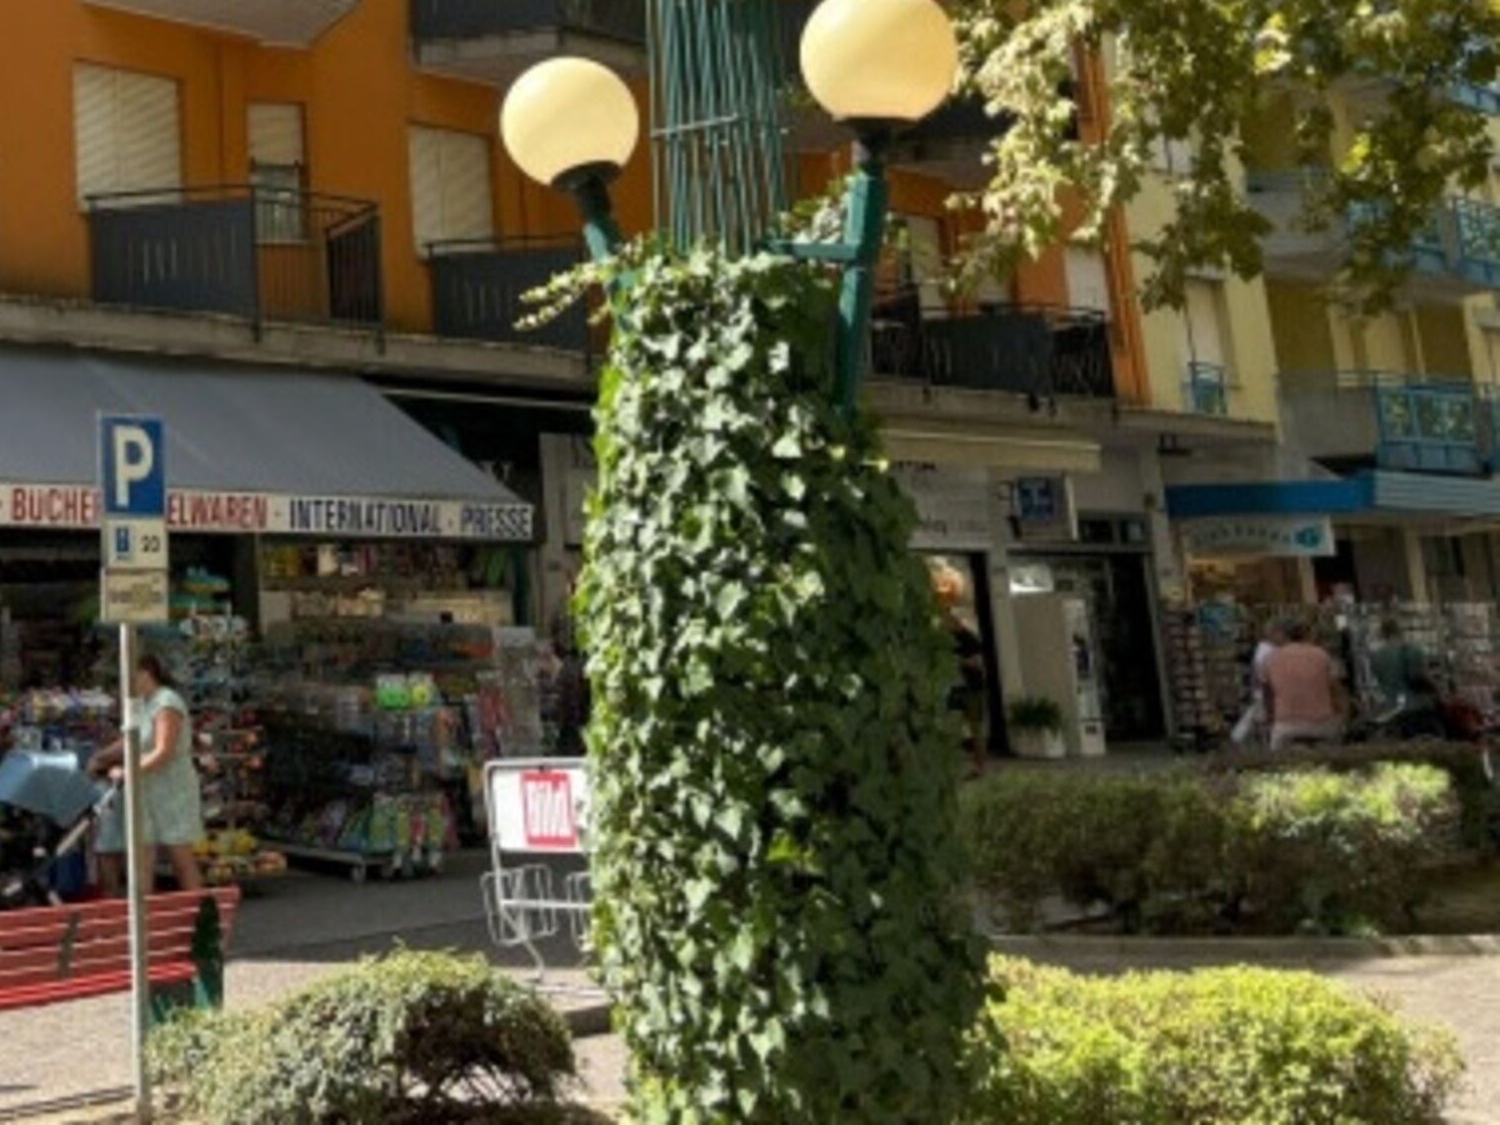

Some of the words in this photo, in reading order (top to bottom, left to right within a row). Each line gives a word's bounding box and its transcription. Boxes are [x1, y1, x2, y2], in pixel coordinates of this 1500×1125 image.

[114, 425, 154, 509] P
[290, 499, 441, 533] INTERNATIONAL
[460, 506, 528, 537] PRESSE
